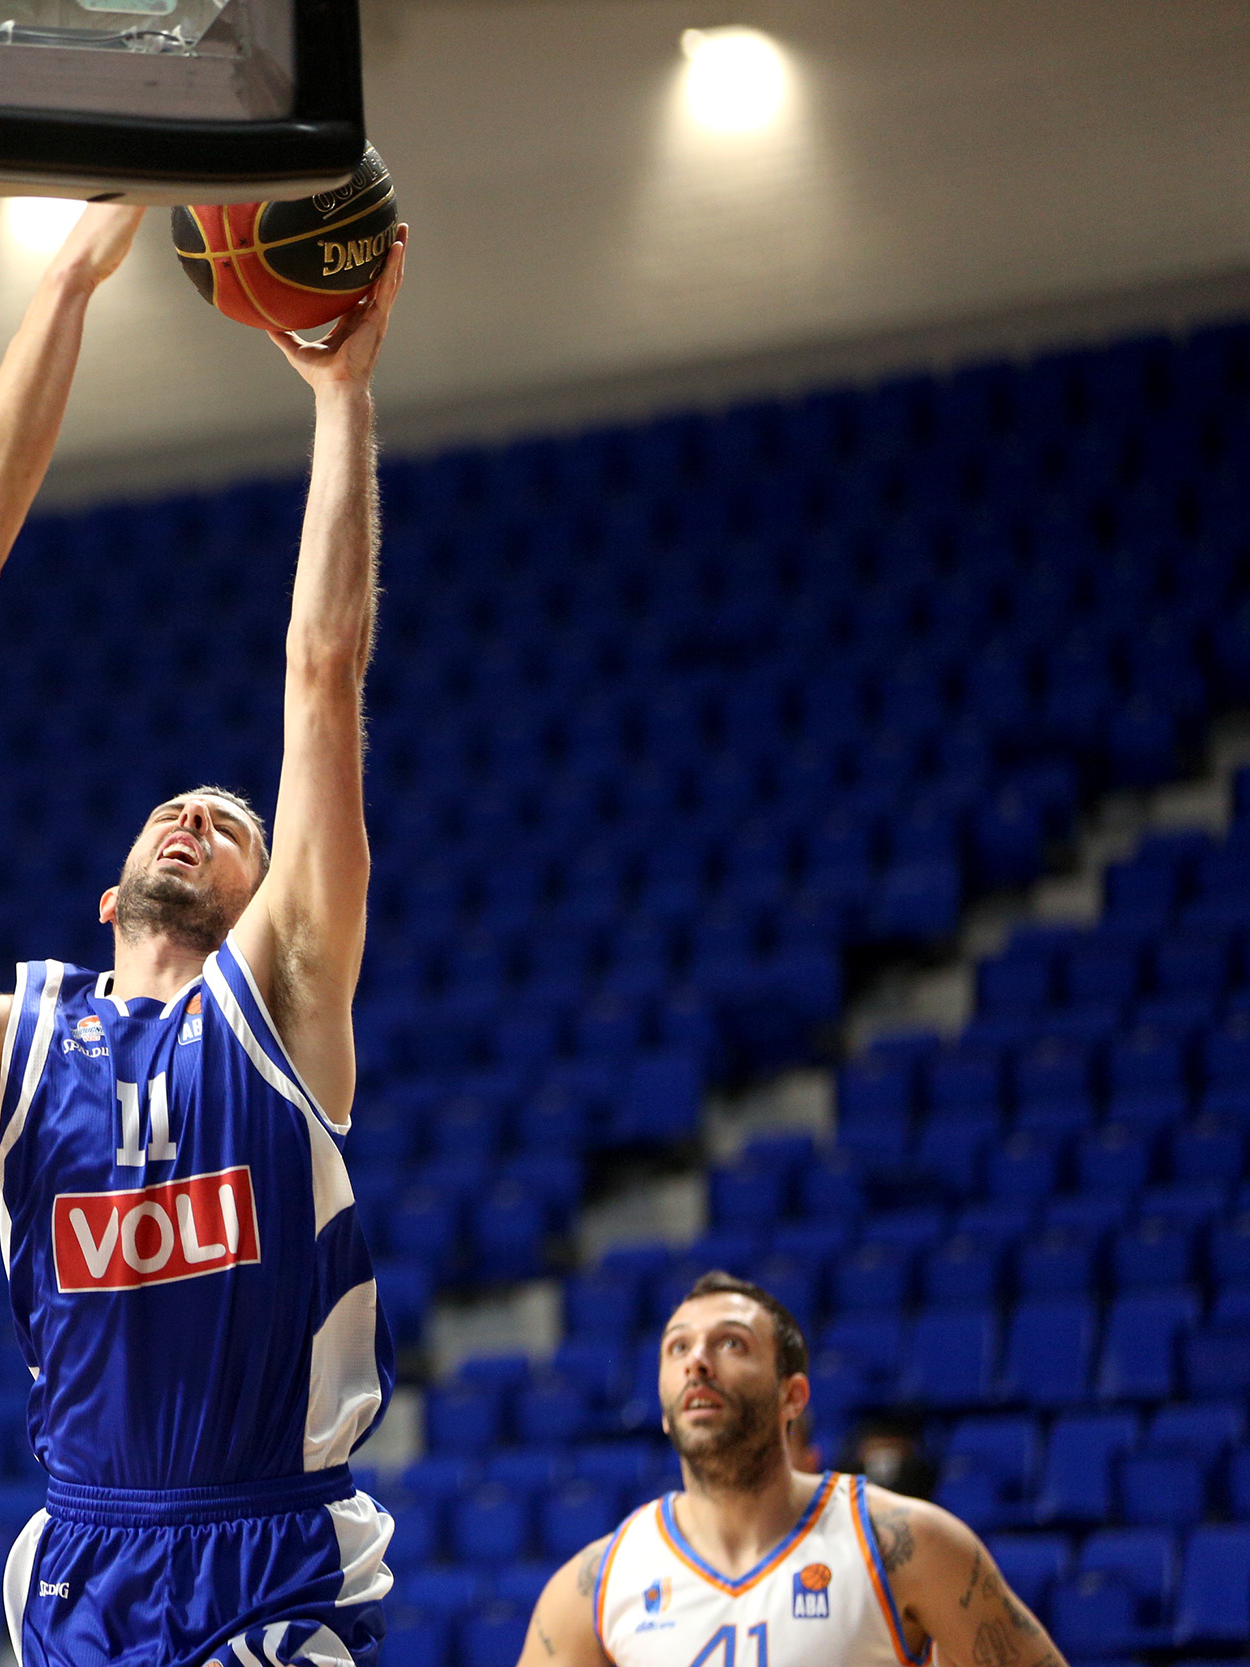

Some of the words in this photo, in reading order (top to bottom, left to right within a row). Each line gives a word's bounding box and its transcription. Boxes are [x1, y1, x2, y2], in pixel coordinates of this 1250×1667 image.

[182, 1018, 203, 1042] AB
[116, 1071, 177, 1167] 11
[69, 1184, 240, 1279] VOLI
[794, 1594, 828, 1617] ABA
[688, 1621, 769, 1667] 41
